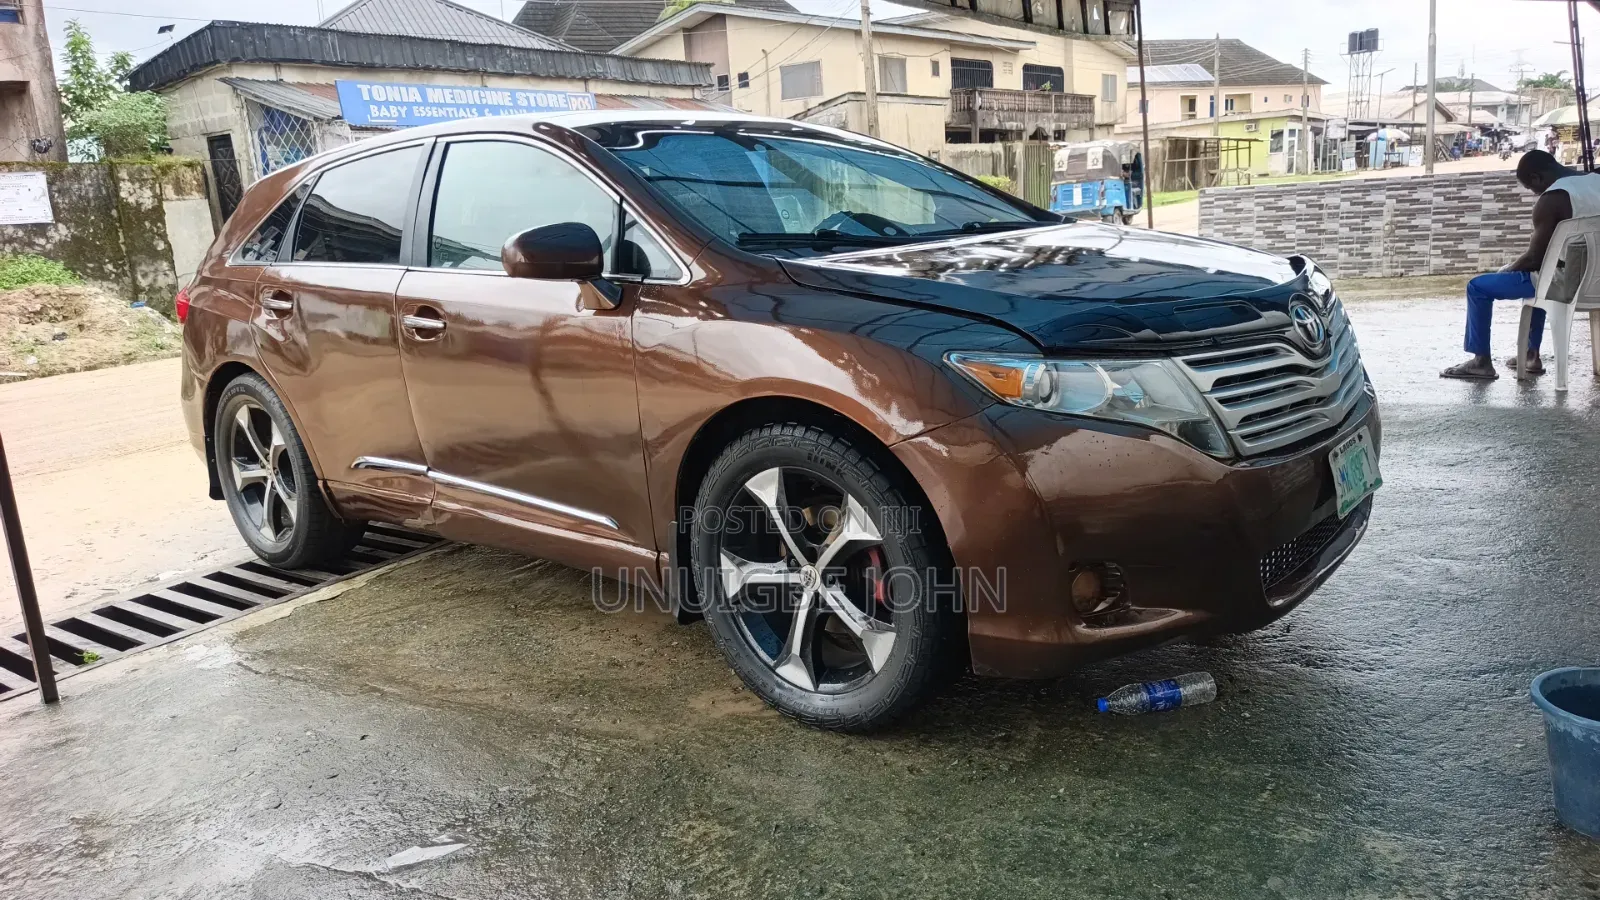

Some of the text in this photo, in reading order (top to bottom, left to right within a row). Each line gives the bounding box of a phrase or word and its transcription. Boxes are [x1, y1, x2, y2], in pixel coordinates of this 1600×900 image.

[357, 84, 568, 108] TONIA MEDICINE STORE
[369, 104, 407, 118] BABY
[412, 105, 478, 118] ESSENTIALS
